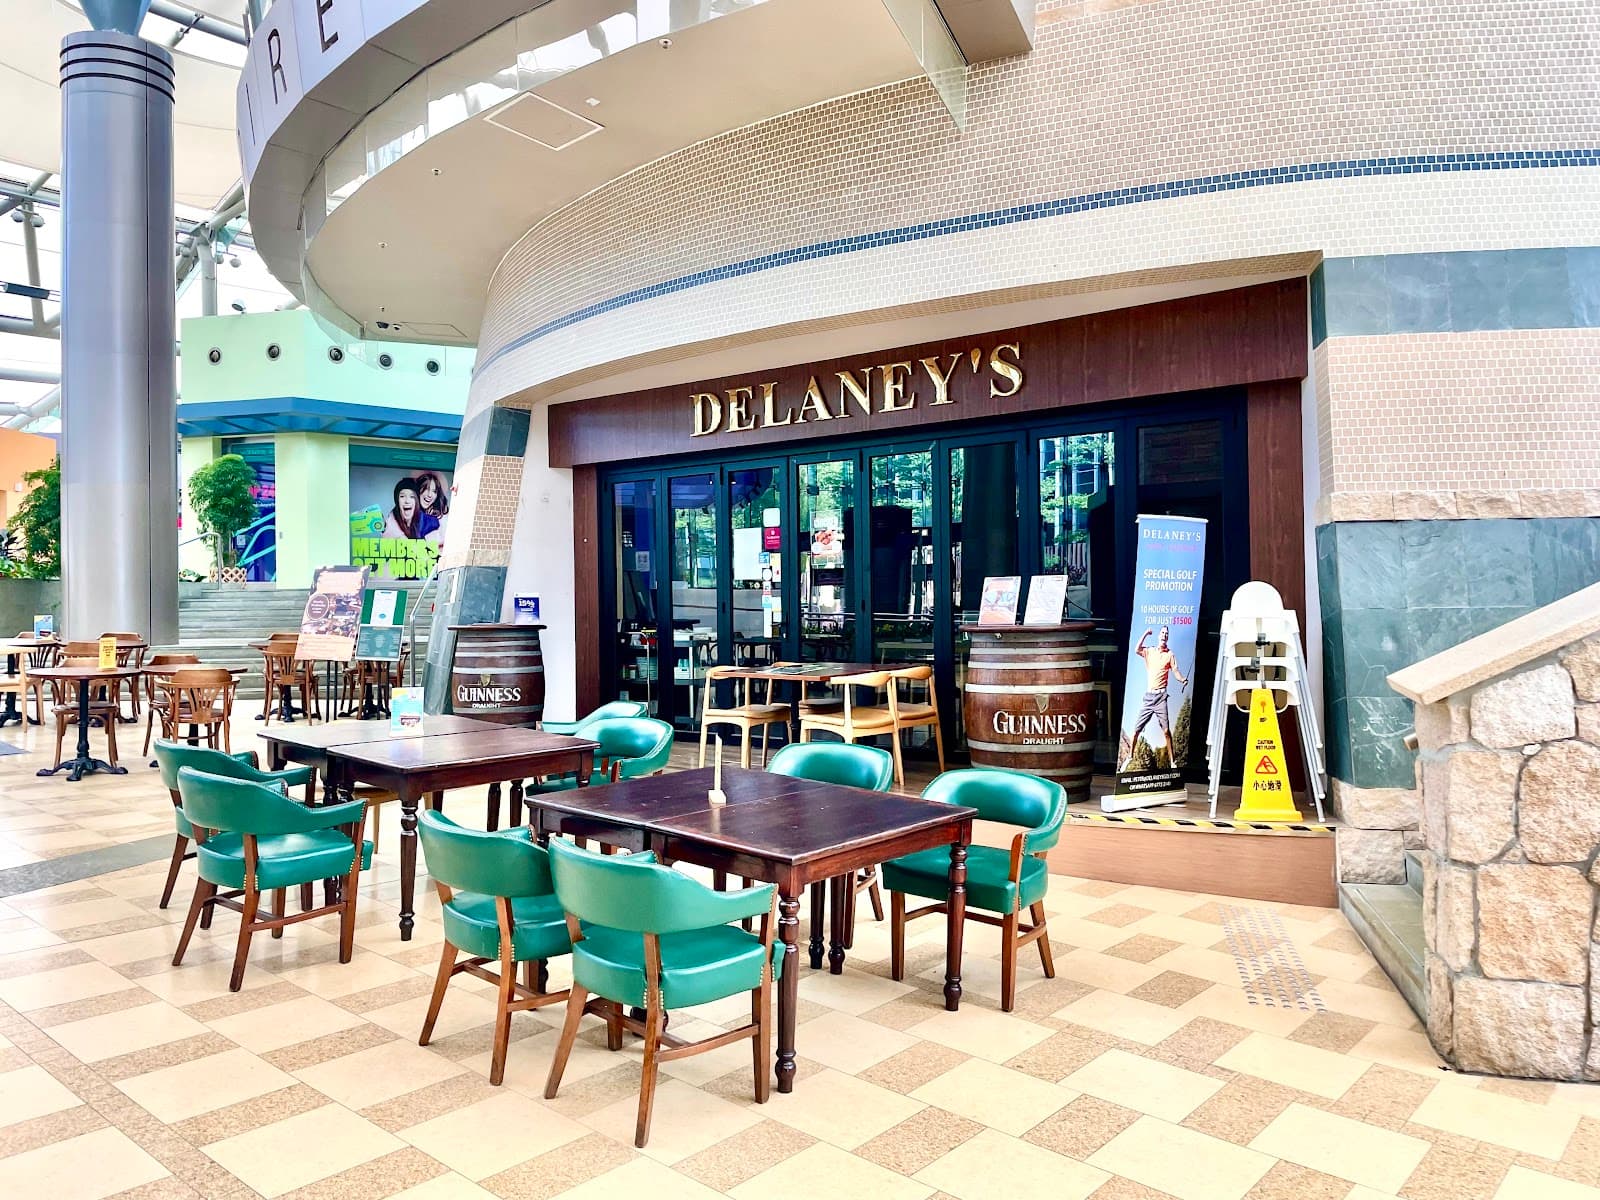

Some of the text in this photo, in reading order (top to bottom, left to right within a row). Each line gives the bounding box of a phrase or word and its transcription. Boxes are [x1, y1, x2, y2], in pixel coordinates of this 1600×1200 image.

[688, 341, 1024, 438] DELANEY'S
[1143, 529, 1201, 542] DELANEY'S
[352, 537, 439, 560] MEMBERS
[1143, 569, 1198, 580] SPECIAL GOLF
[1145, 581, 1193, 592] PROMOTION
[1148, 605, 1169, 614] HOURS
[1170, 605, 1178, 614] OF
[1178, 605, 1195, 614] GOLF
[1145, 616, 1157, 625] FOR
[1157, 616, 1172, 625] JUST
[457, 685, 521, 702] GUINNESS
[993, 711, 1086, 735] GUINNESS
[1023, 737, 1065, 745] DRAUGHT
